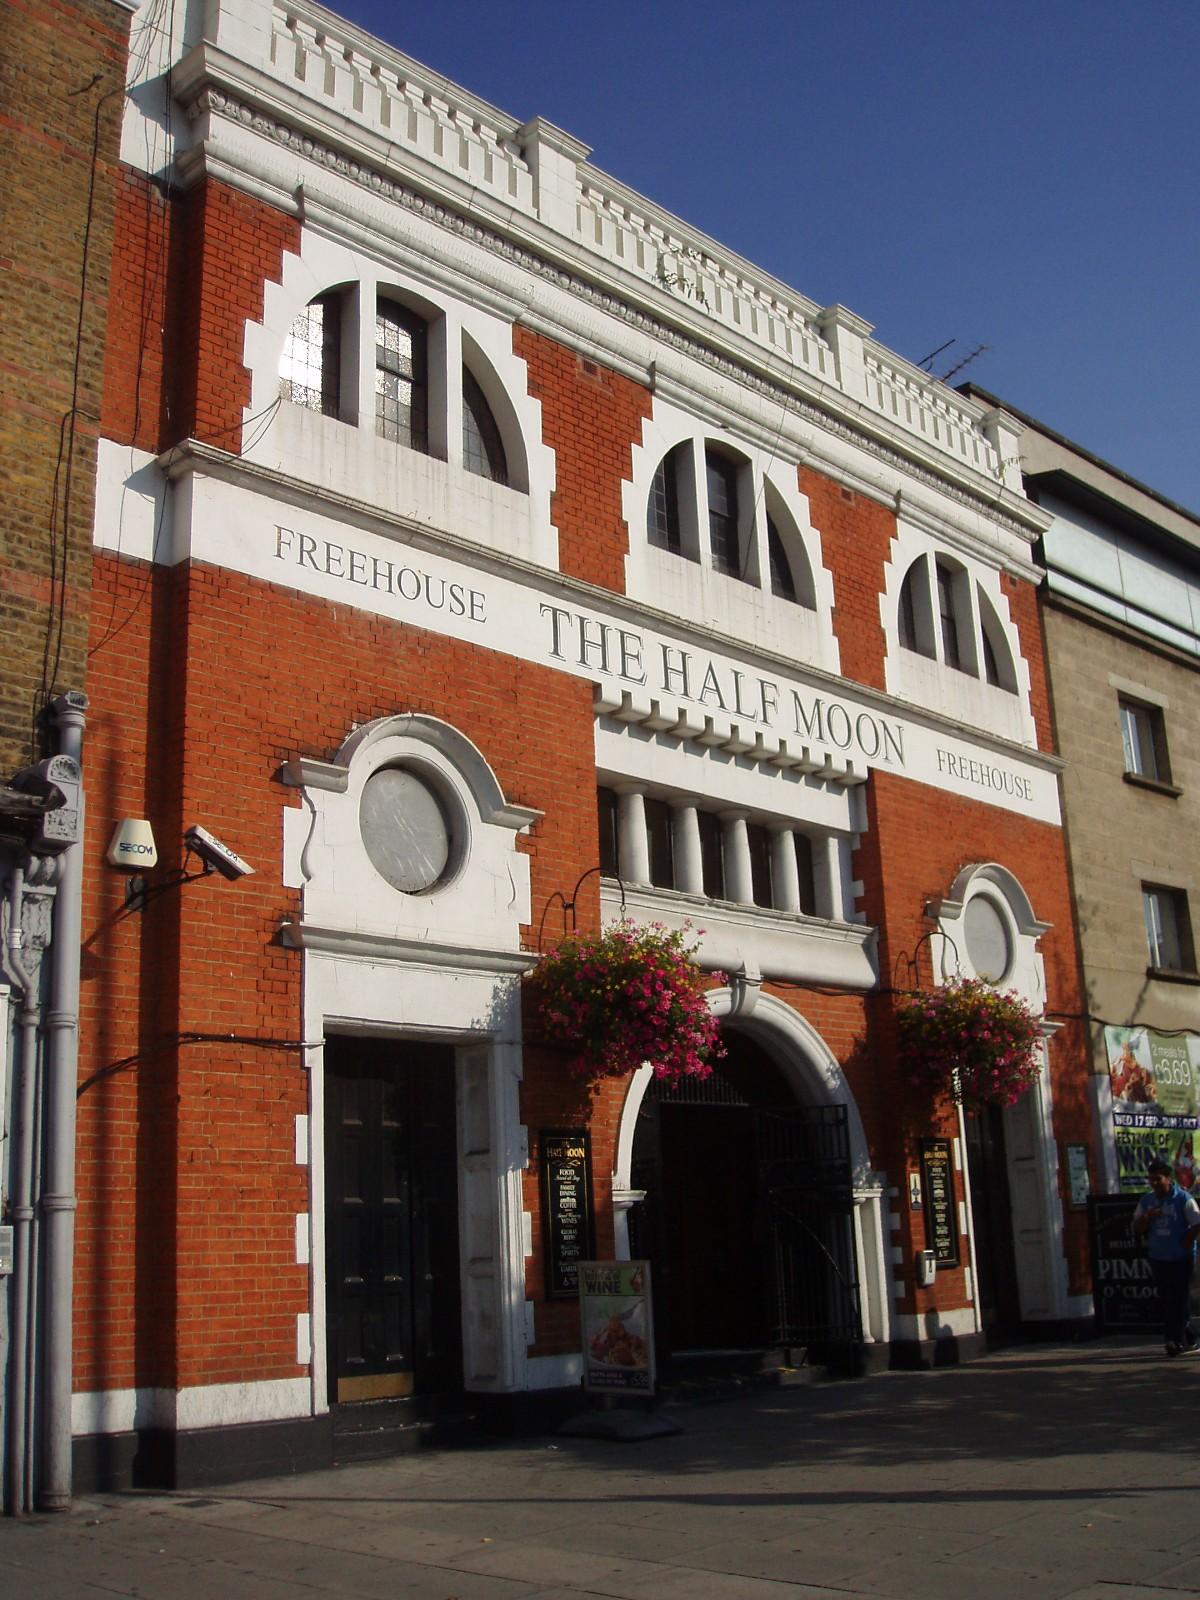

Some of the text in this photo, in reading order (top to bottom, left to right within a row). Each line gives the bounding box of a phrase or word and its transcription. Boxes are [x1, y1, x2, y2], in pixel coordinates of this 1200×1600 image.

[272, 523, 488, 624] FREEHOUSE
[538, 602, 906, 769] THE HALF MOON
[935, 747, 1034, 801] FREEHOUSE
[119, 842, 153, 855] SECOM
[1151, 1043, 1158, 1056] 2
[1155, 1059, 1192, 1086] £6.69
[1115, 1114, 1133, 1126] WED
[1135, 1115, 1144, 1126] 17
[1145, 1115, 1158, 1127] SEP
[1159, 1133, 1169, 1146] OF
[585, 1280, 622, 1294] WINE
